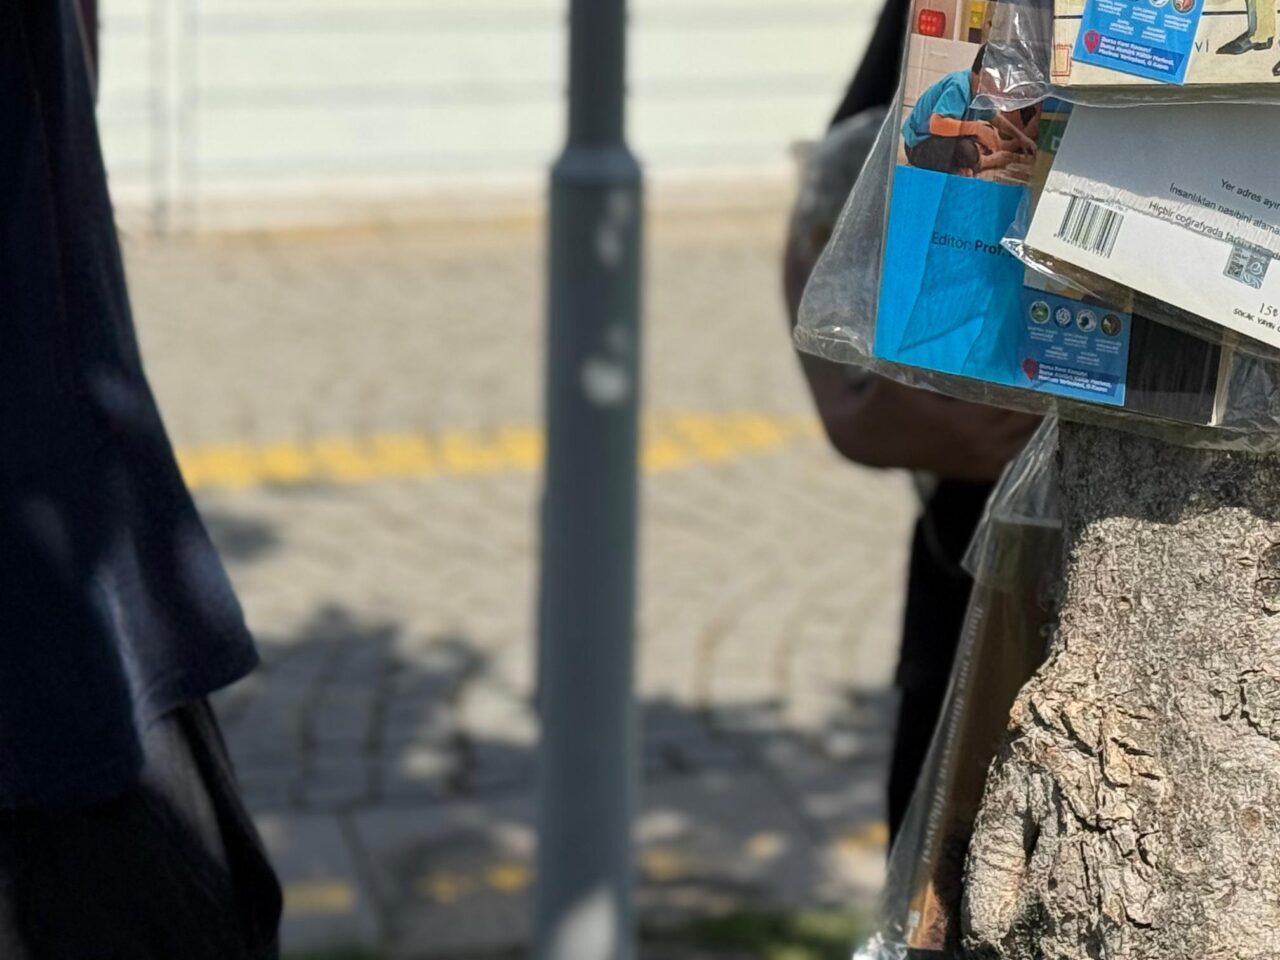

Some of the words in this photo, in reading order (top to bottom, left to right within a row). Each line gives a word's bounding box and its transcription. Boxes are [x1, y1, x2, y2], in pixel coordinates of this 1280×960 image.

[1221, 178, 1236, 192] Yer
[1236, 187, 1262, 203] adres
[1148, 200, 1176, 218] Hiçbir
[1175, 213, 1224, 239] coğrafyada
[1217, 204, 1252, 223] nasibini
